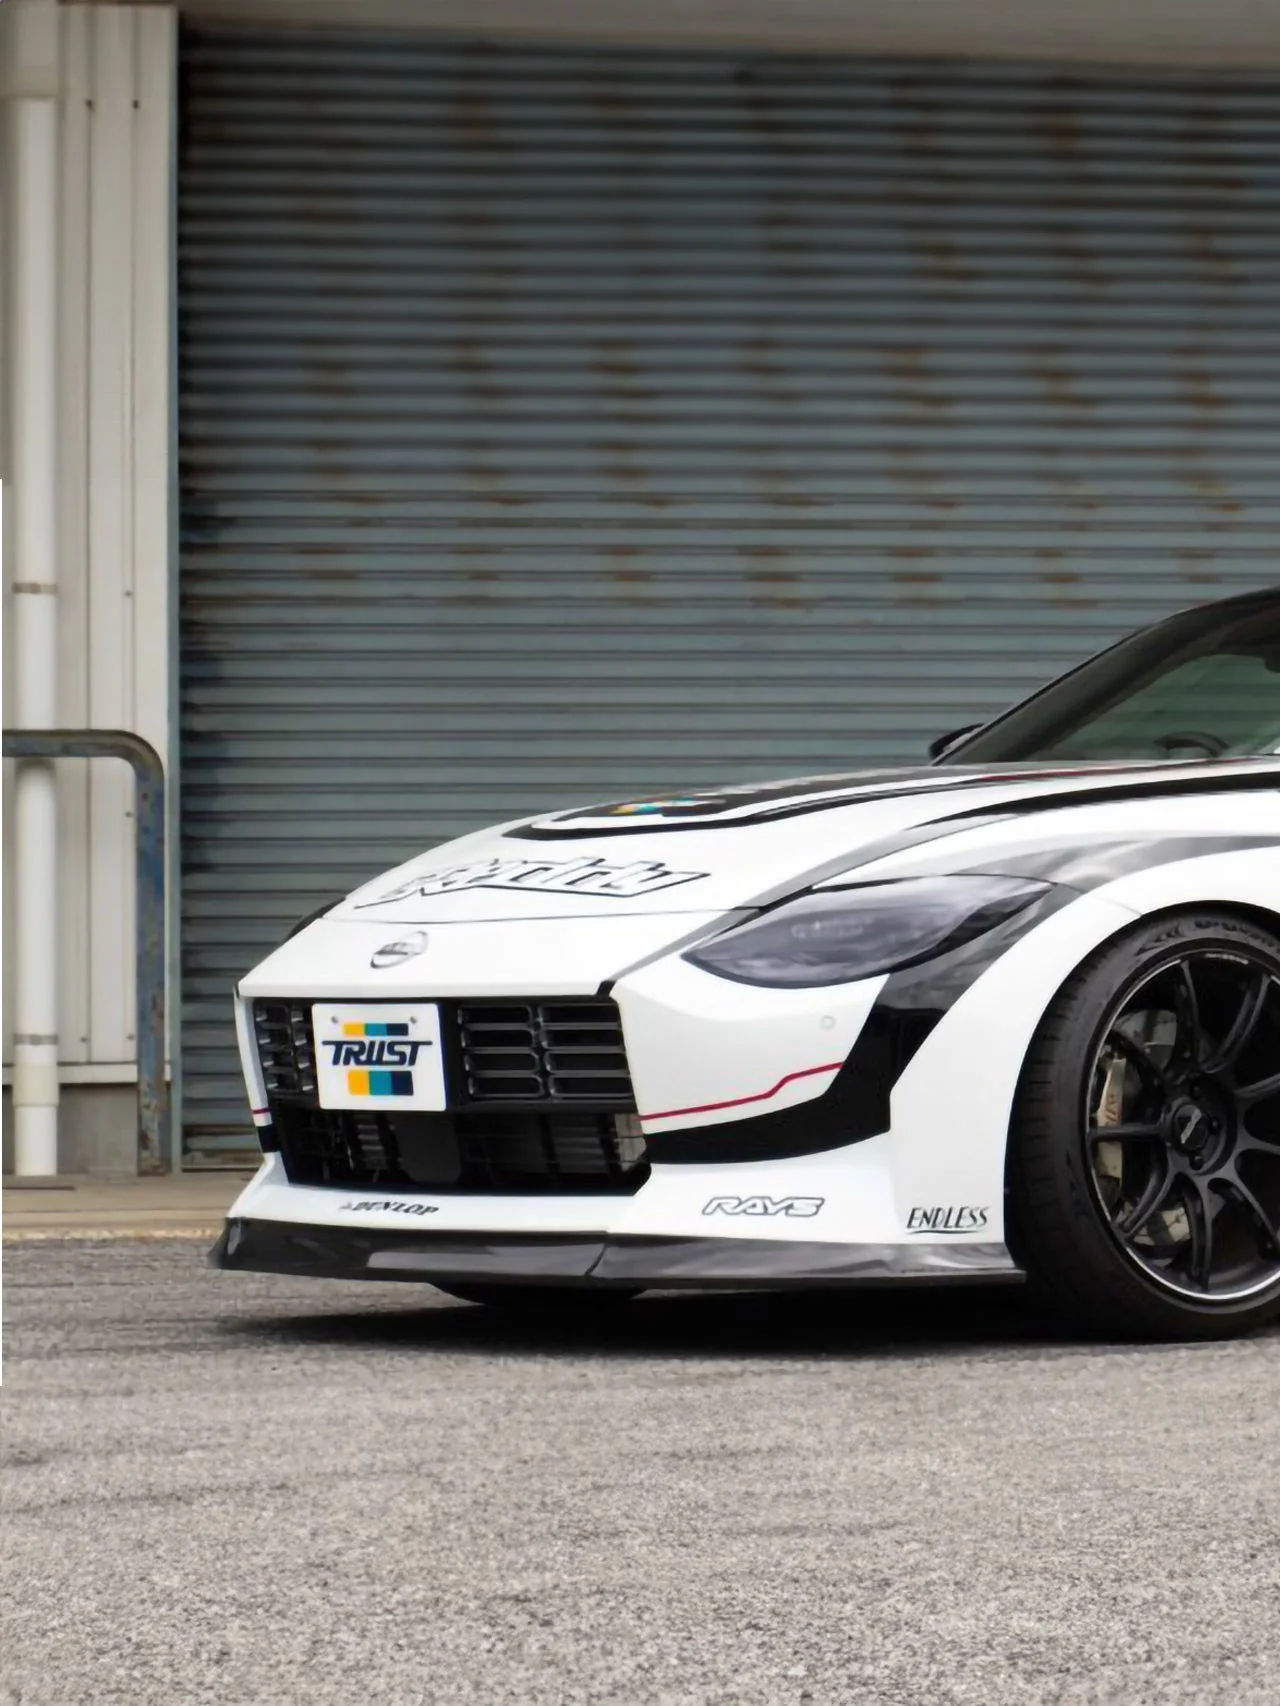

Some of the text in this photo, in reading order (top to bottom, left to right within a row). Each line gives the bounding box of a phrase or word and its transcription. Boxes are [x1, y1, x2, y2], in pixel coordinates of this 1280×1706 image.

[322, 1040, 433, 1067] TRUST
[702, 1196, 826, 1217] RAYS
[907, 1207, 991, 1230] ENDLESS
